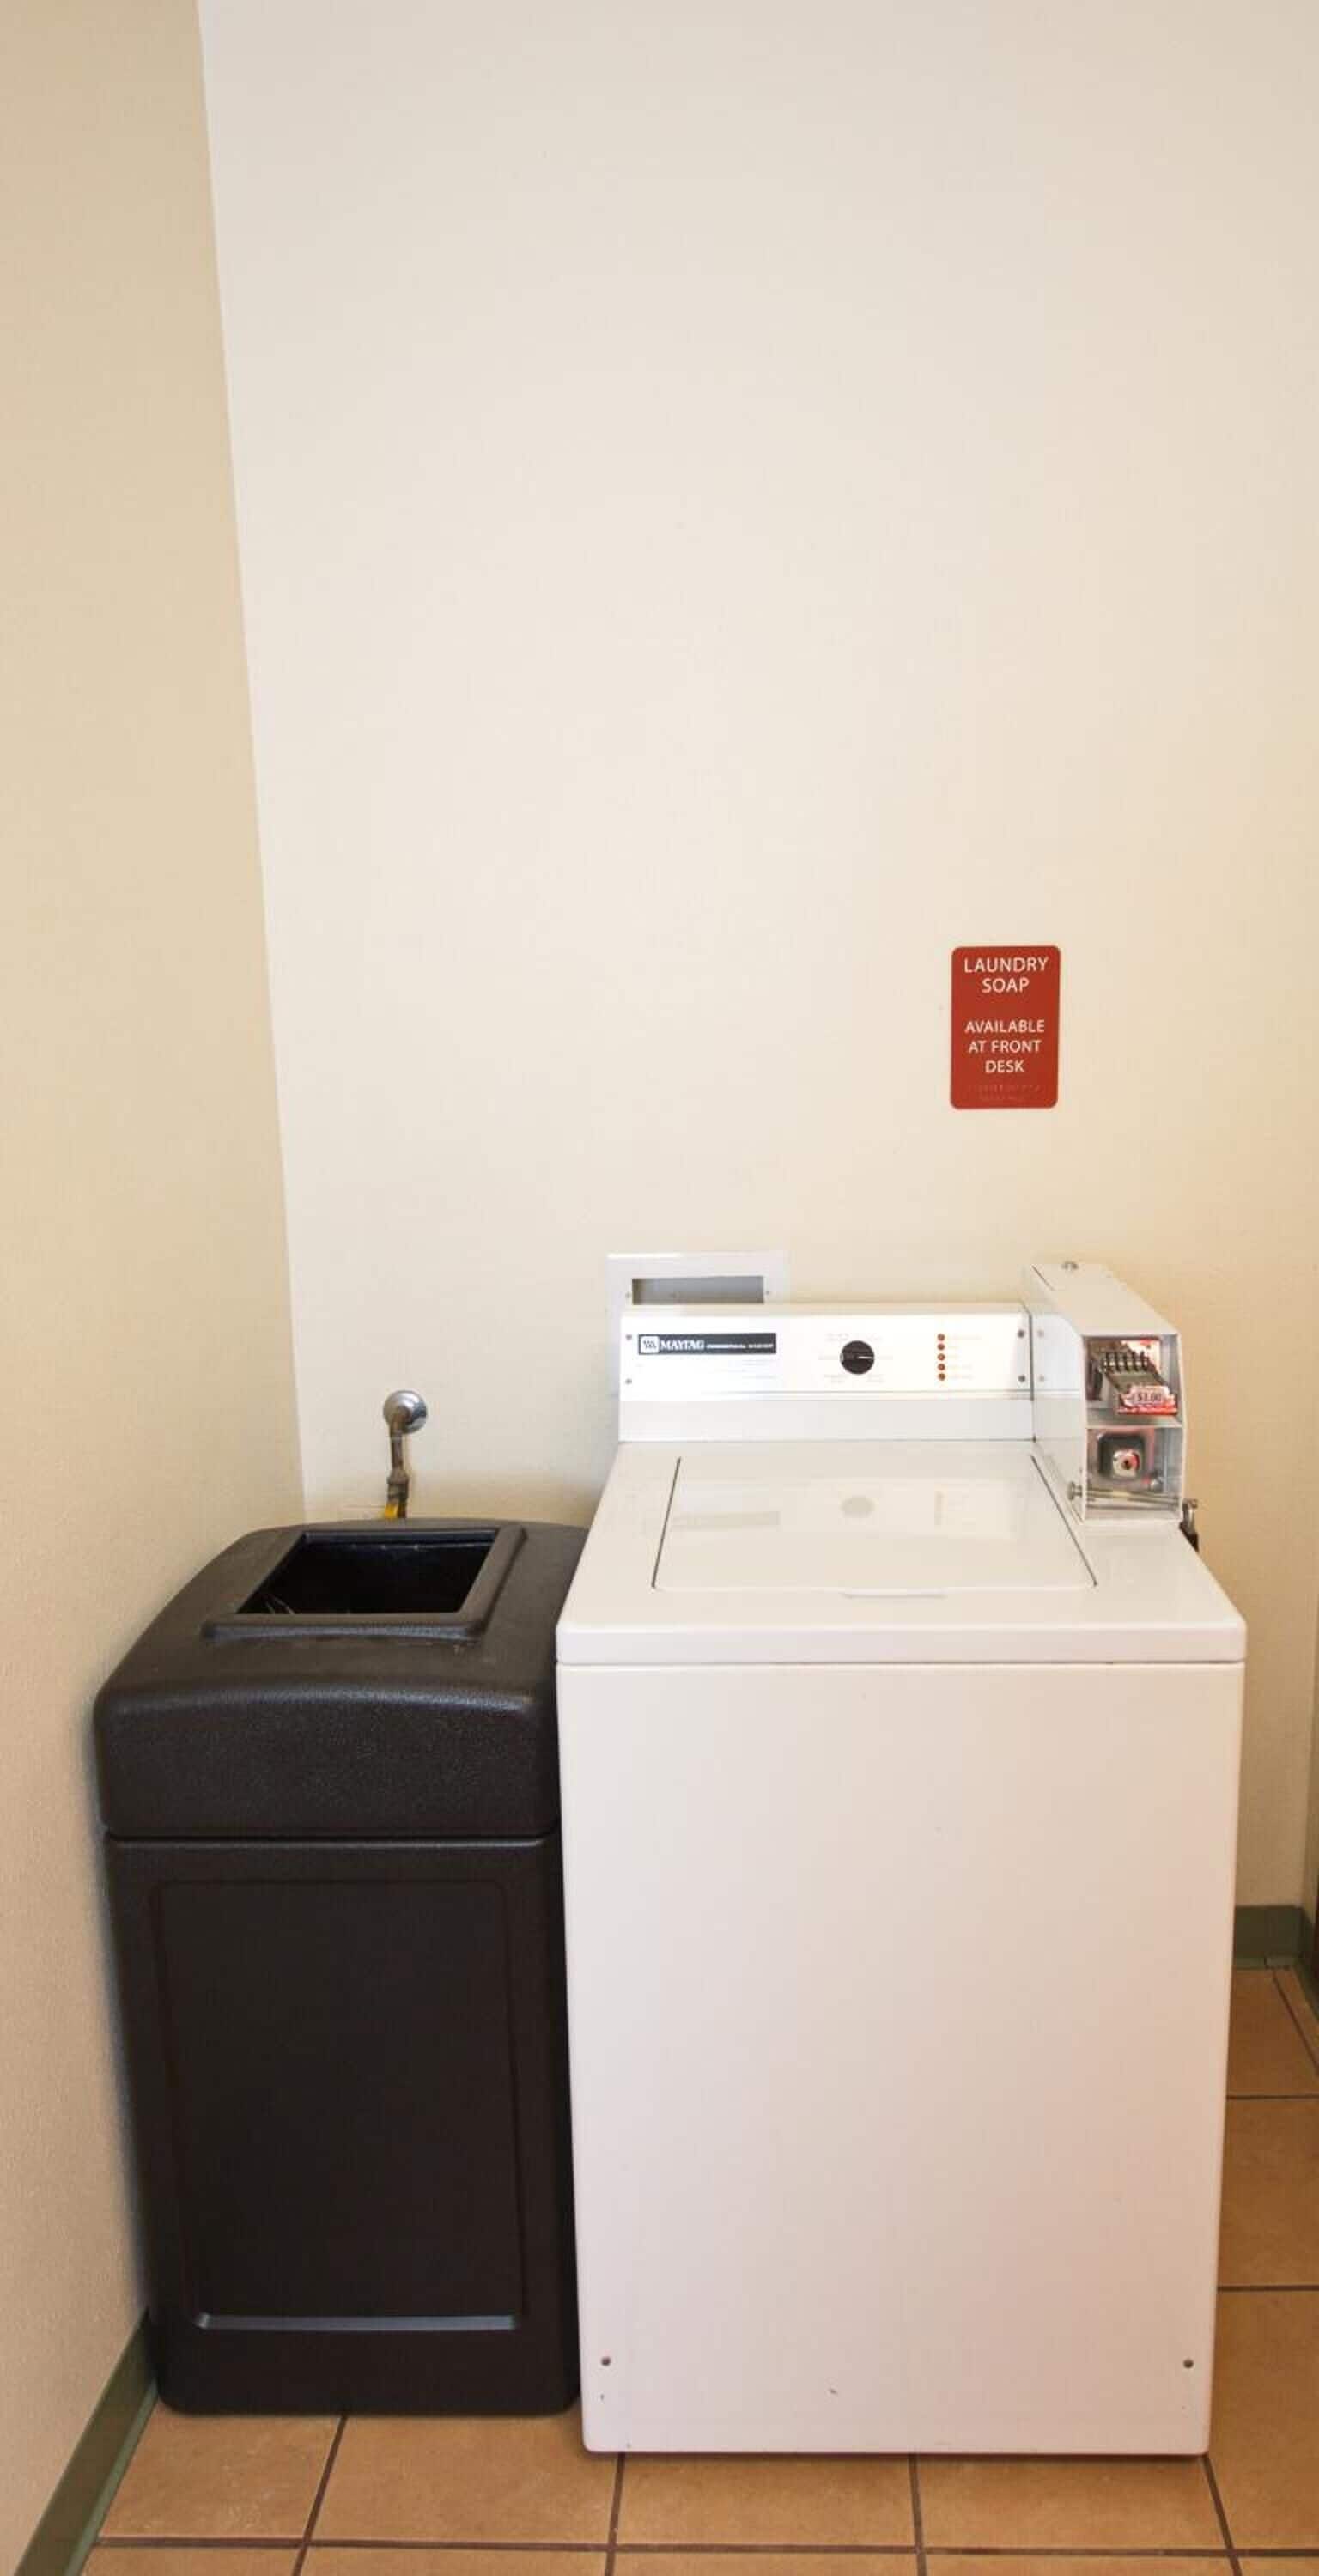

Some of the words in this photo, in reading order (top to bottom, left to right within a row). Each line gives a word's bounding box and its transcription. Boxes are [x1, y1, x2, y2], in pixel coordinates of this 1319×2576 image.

[963, 957, 1049, 973] LAUNDRY
[982, 977, 1030, 993] SOAP
[964, 1019, 1045, 1033] AVAILABLE
[968, 1040, 987, 1054] AT
[991, 1040, 1042, 1053] FRONT
[985, 1060, 1024, 1072] DESK
[660, 1339, 704, 1351] MAYTAG
